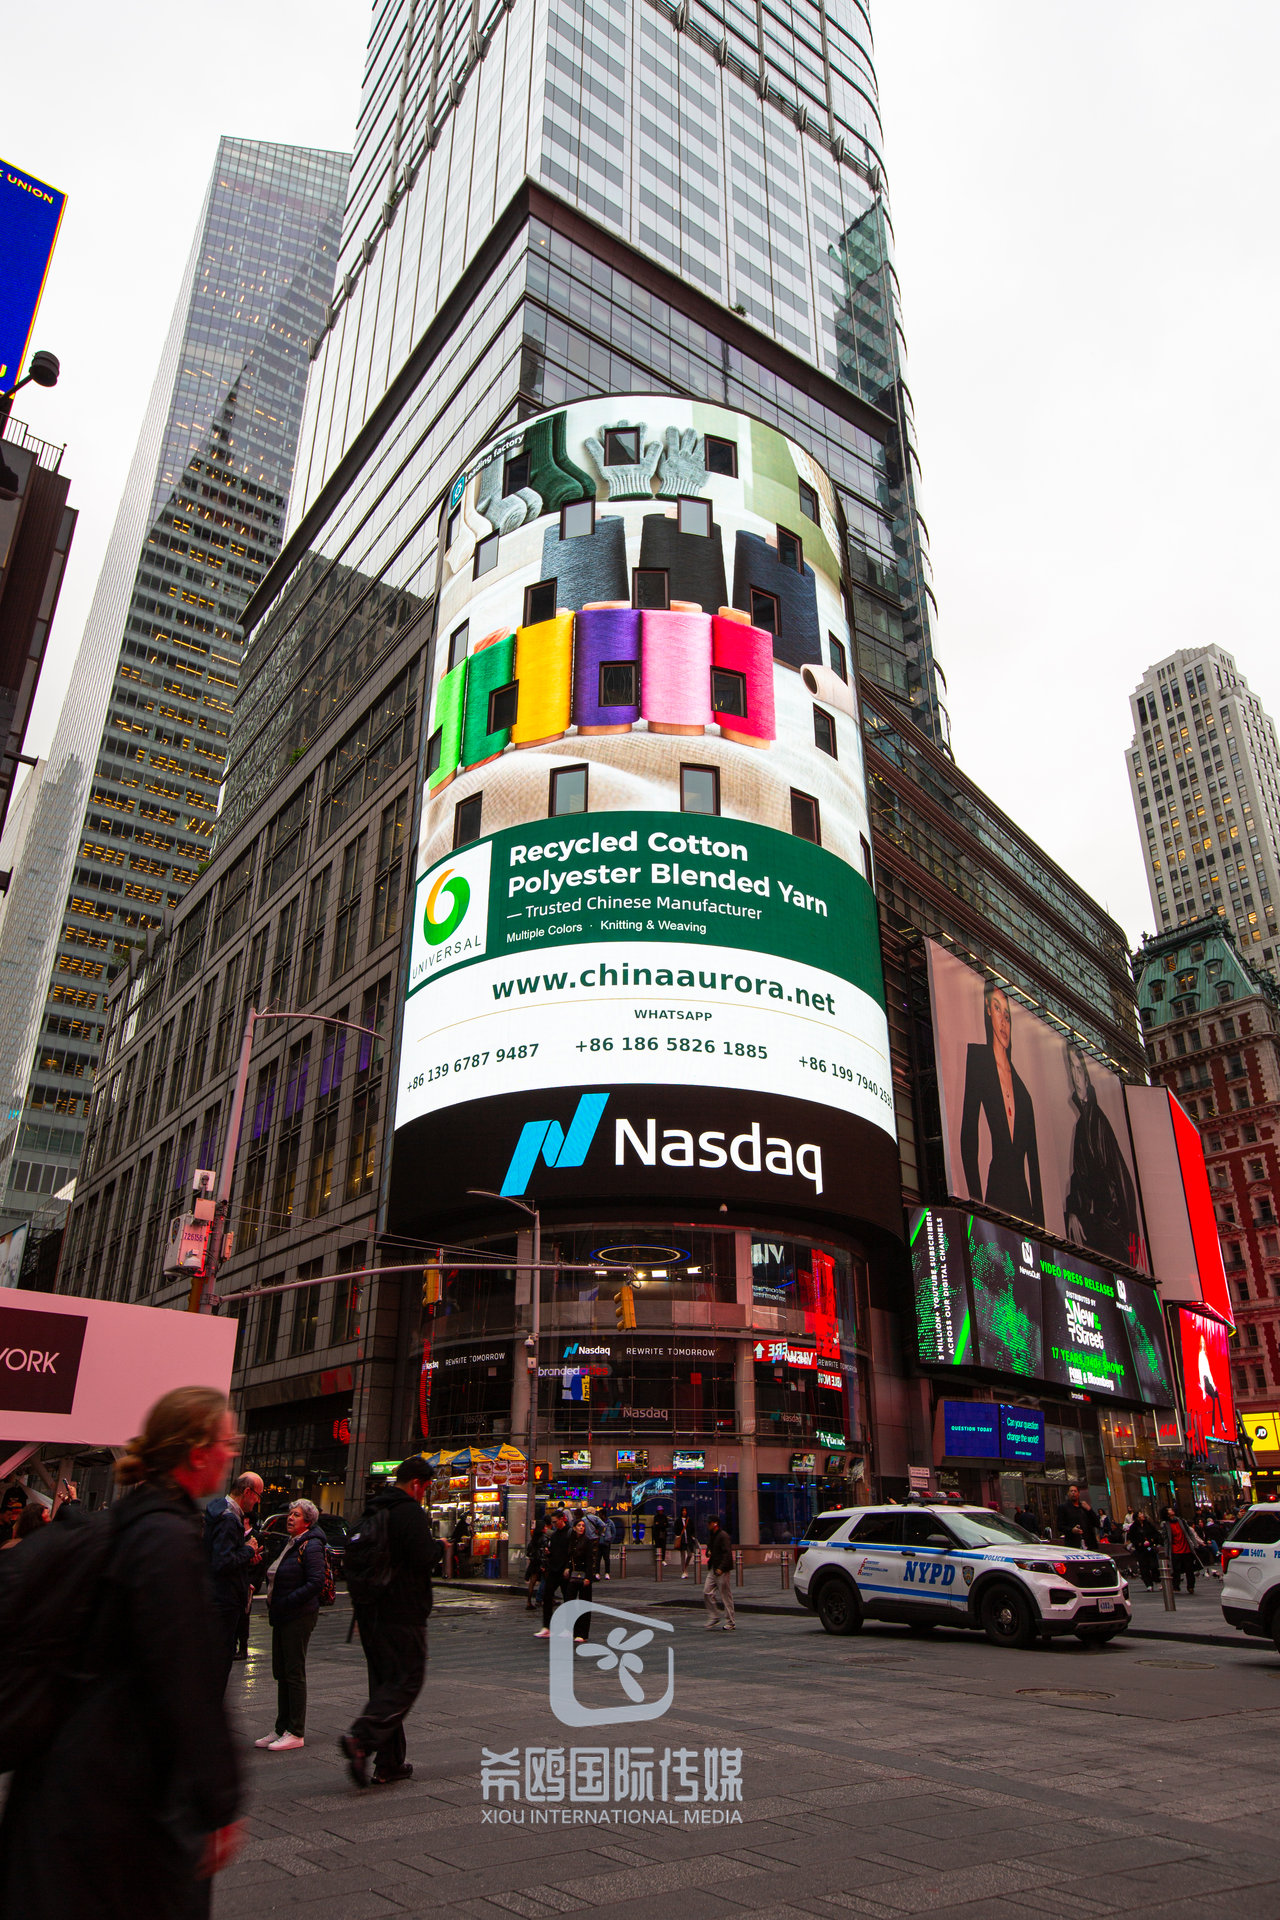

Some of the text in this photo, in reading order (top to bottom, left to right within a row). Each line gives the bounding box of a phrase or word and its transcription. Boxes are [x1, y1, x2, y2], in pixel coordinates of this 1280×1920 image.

[7, 173, 53, 204] UNION
[494, 434, 524, 457] factory
[509, 831, 748, 867] Recycled Cotton
[508, 863, 828, 917] Polyester Blended Yarn
[526, 898, 581, 918] Trusted
[586, 897, 651, 910] Chinese
[657, 896, 762, 920] Manufacturer
[506, 920, 707, 943] Multiple Colors Knitting & Weaving
[412, 935, 481, 979] UNIVERSAL
[492, 962, 836, 1015] www.chinaaurora.net
[634, 1009, 713, 1021] WHATSAPP
[575, 1037, 768, 1059] +86 186 5826 1885
[407, 1043, 540, 1092] +86 139 6787 9487
[799, 1056, 827, 1073] +86
[831, 1063, 853, 1082] 199
[856, 1073, 878, 1096] 7940
[615, 1118, 823, 1195] Nasdaq
[926, 1211, 937, 1267] SUBSCRIBERS
[930, 1269, 940, 1309] YOUTUBE
[936, 1217, 955, 1355] ACROSS OUR DIGITAL CHANNELS
[1040, 1259, 1115, 1298] VIDEO PRESS RELEASES
[1065, 1290, 1091, 1305] DISTRIBUTED
[1072, 1300, 1095, 1328] New
[935, 1311, 944, 1353] MILLION+
[1076, 1324, 1105, 1350] Street
[469, 1352, 506, 1363] TOMORROW
[578, 1346, 611, 1356] Nasdaq
[626, 1347, 716, 1357] REWRITE TOMORROW
[1051, 1346, 1059, 1359] 17
[1102, 1359, 1125, 1376] SHOWS
[538, 1365, 609, 1376] brandedcities
[623, 1406, 669, 1421] Nasdaq
[951, 1425, 976, 1433] QUESTION
[984, 1554, 1006, 1562] POLICE
[903, 1561, 956, 1586] NYPD
